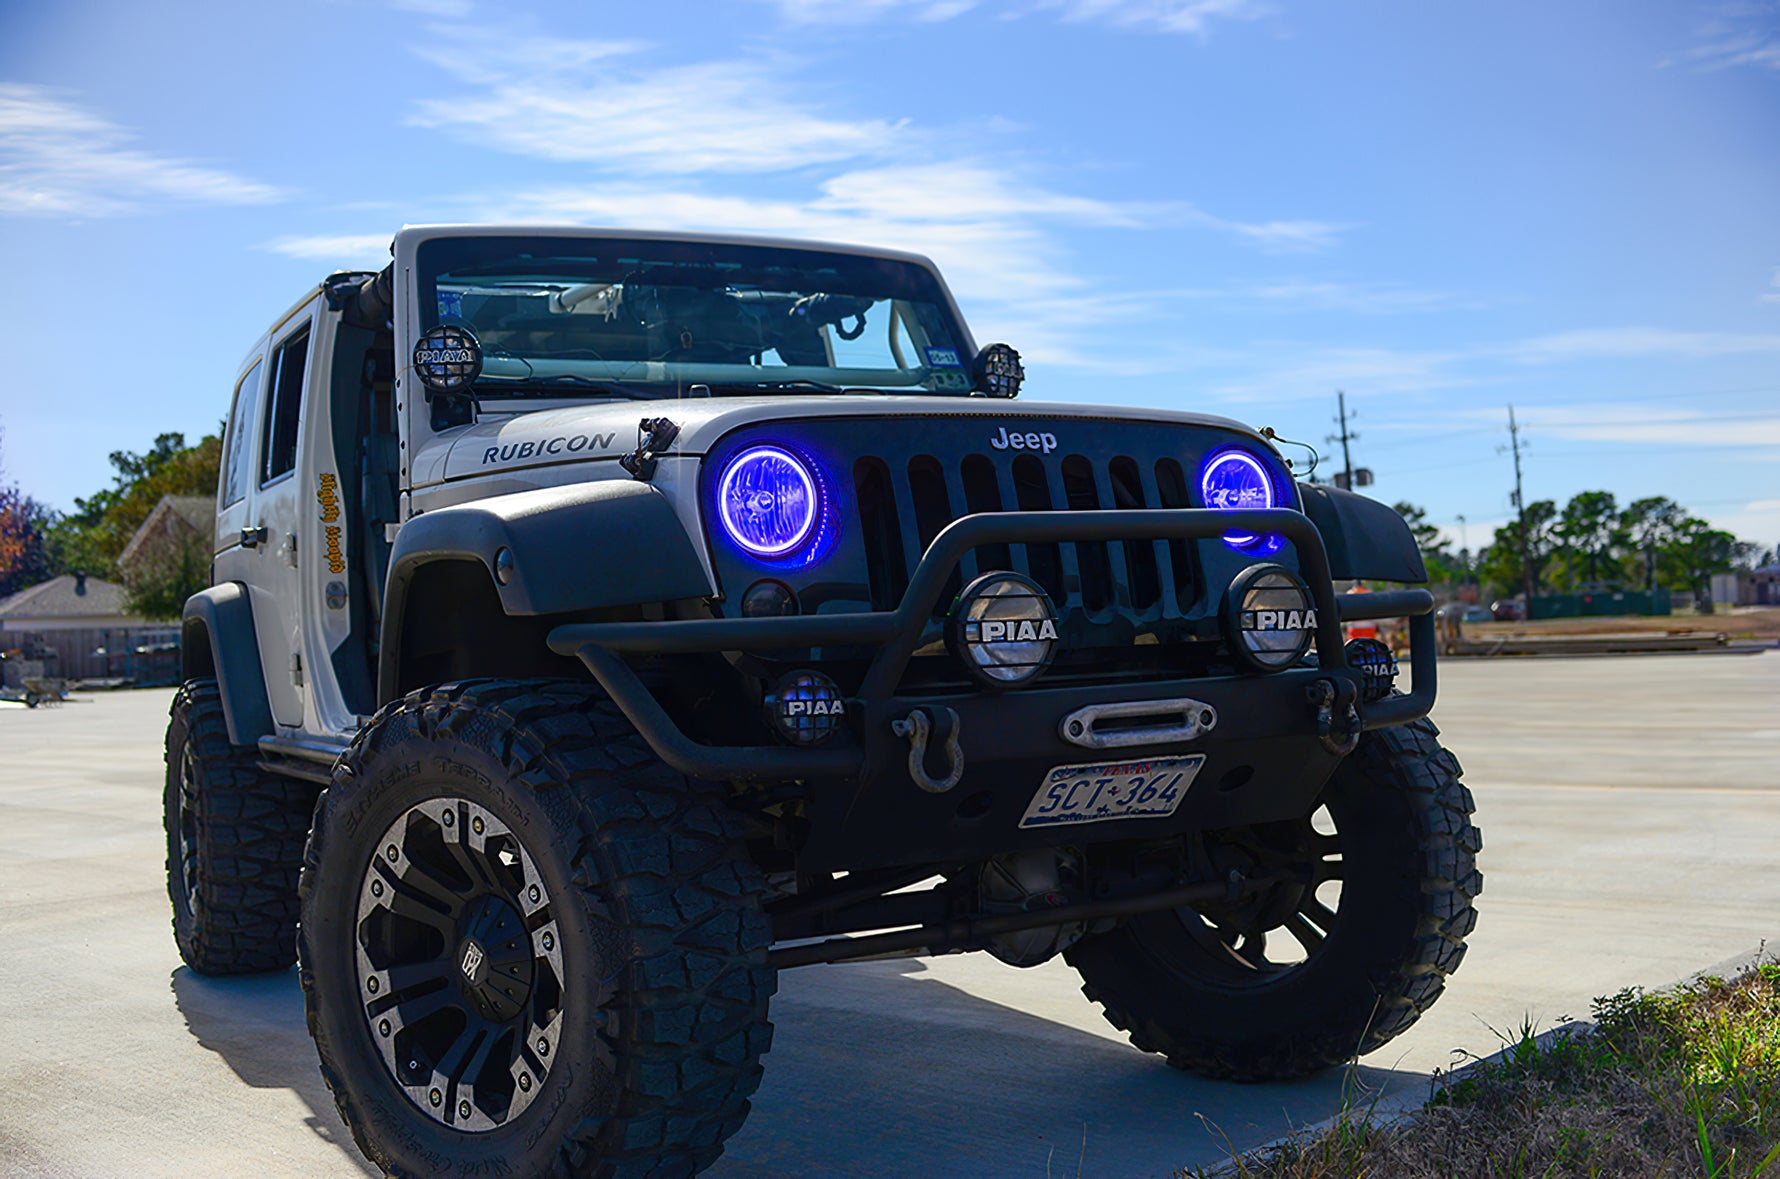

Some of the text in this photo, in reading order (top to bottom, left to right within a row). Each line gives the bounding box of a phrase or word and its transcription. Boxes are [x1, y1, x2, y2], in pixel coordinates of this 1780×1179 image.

[482, 432, 616, 465] RUBICON
[990, 427, 1058, 454] Jeep
[1257, 609, 1318, 630] PIAA
[981, 619, 1059, 642] PIAA
[1361, 663, 1399, 676] PIAA
[788, 700, 845, 716] PIAA
[1102, 762, 1153, 777] TEXAS
